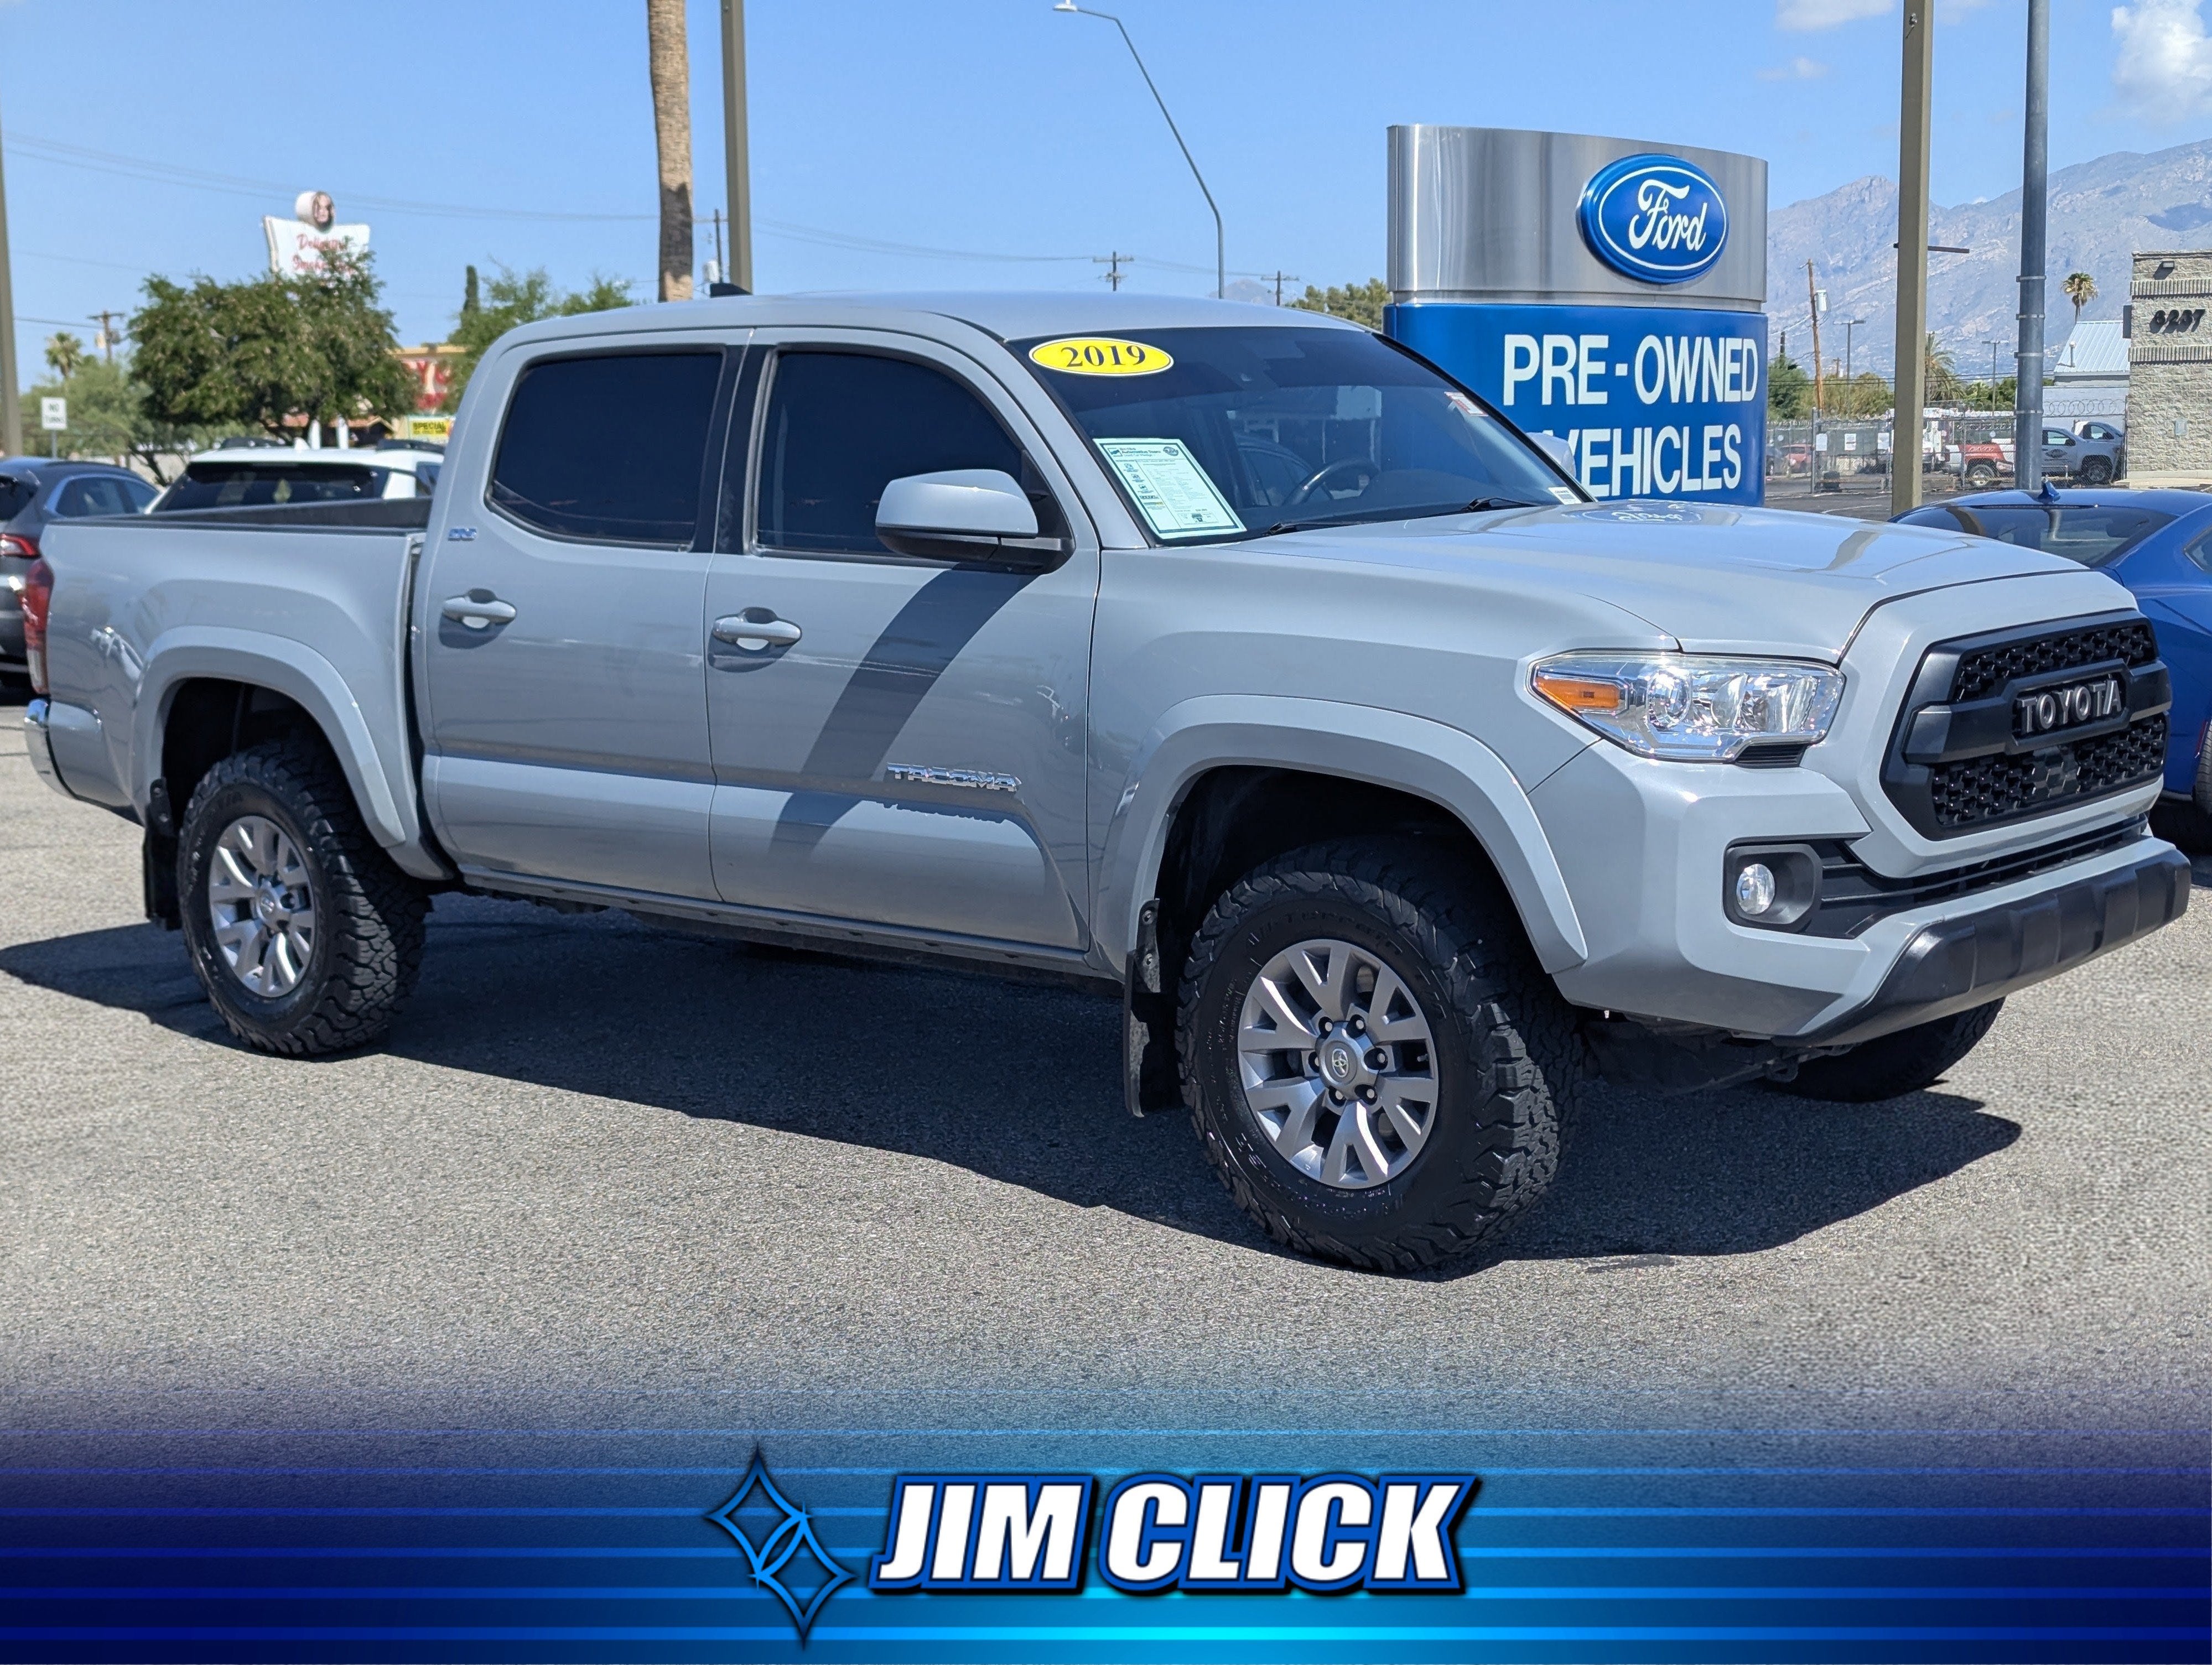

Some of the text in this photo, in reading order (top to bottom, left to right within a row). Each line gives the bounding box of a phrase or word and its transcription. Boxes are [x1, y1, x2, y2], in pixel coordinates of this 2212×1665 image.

[1628, 179, 1709, 251] Ford
[1060, 345, 1146, 368] 2019
[1503, 334, 1758, 406] PRE-OWNED
[2017, 679, 2122, 733] TOYOTA
